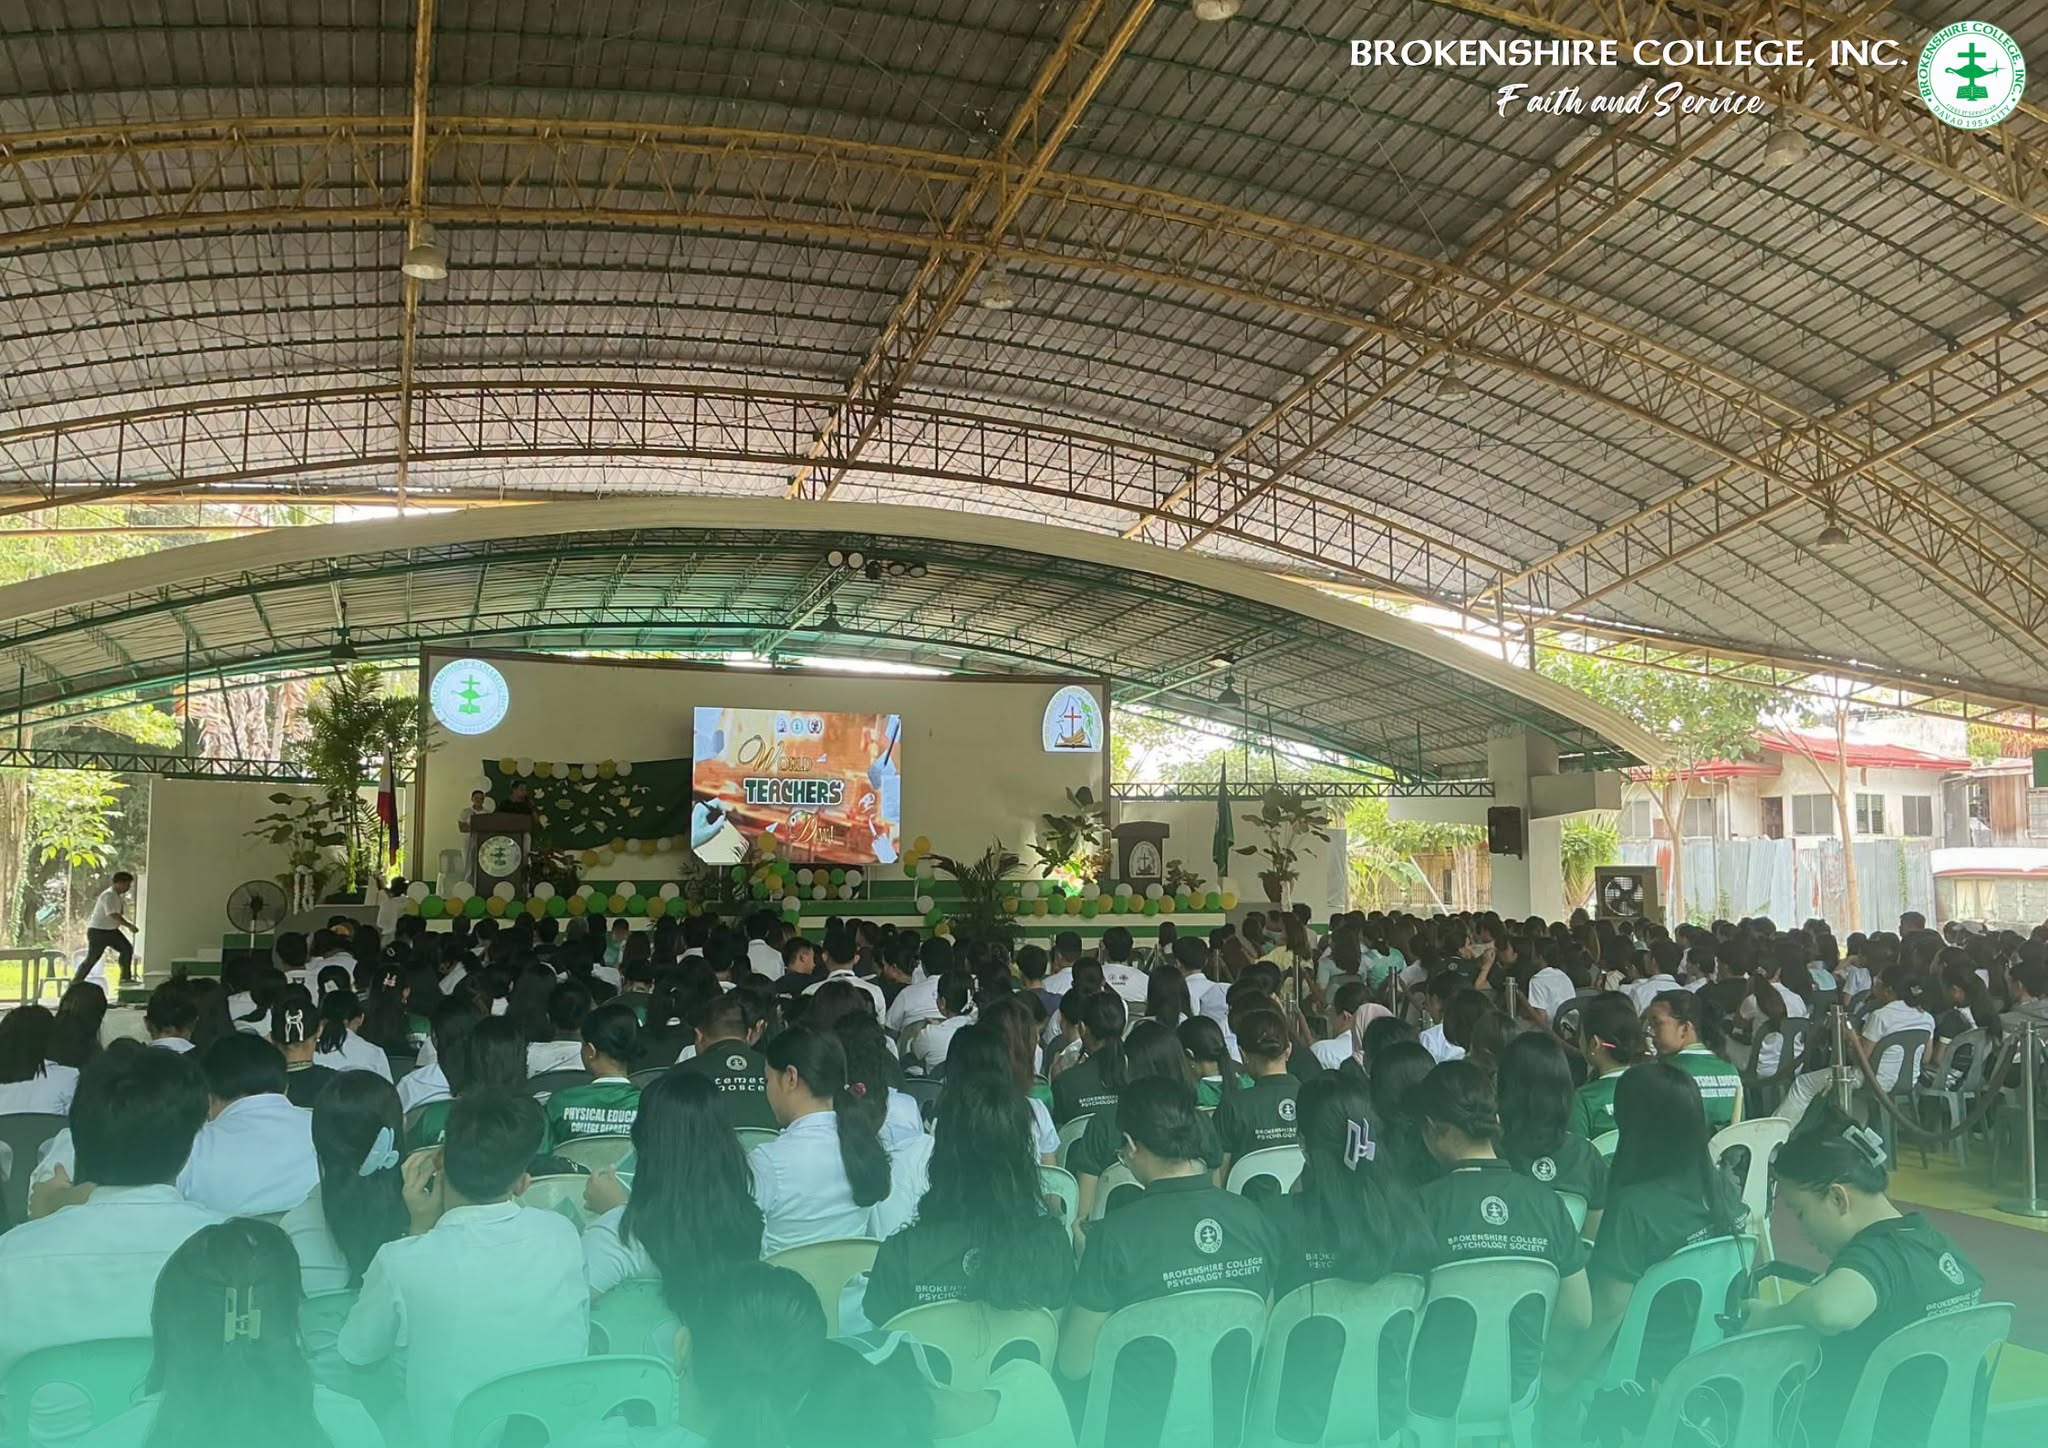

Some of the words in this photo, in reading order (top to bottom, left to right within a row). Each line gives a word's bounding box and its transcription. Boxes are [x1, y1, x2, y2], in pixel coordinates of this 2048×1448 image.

[563, 1107, 605, 1122] PHYSICAL
[1448, 1234, 1508, 1245] BROKENSHIRE
[1510, 1235, 1548, 1246] COLLEGE
[1452, 1241, 1507, 1251] PSYCHOLOGY
[1509, 1243, 1545, 1253] SOCIETY
[1162, 1262, 1224, 1281] BROKENSHIRE
[1226, 1257, 1264, 1270] COLLEGE
[1167, 1272, 1223, 1288] PSYCHOLOGY
[1225, 1265, 1262, 1278] SOCIETY
